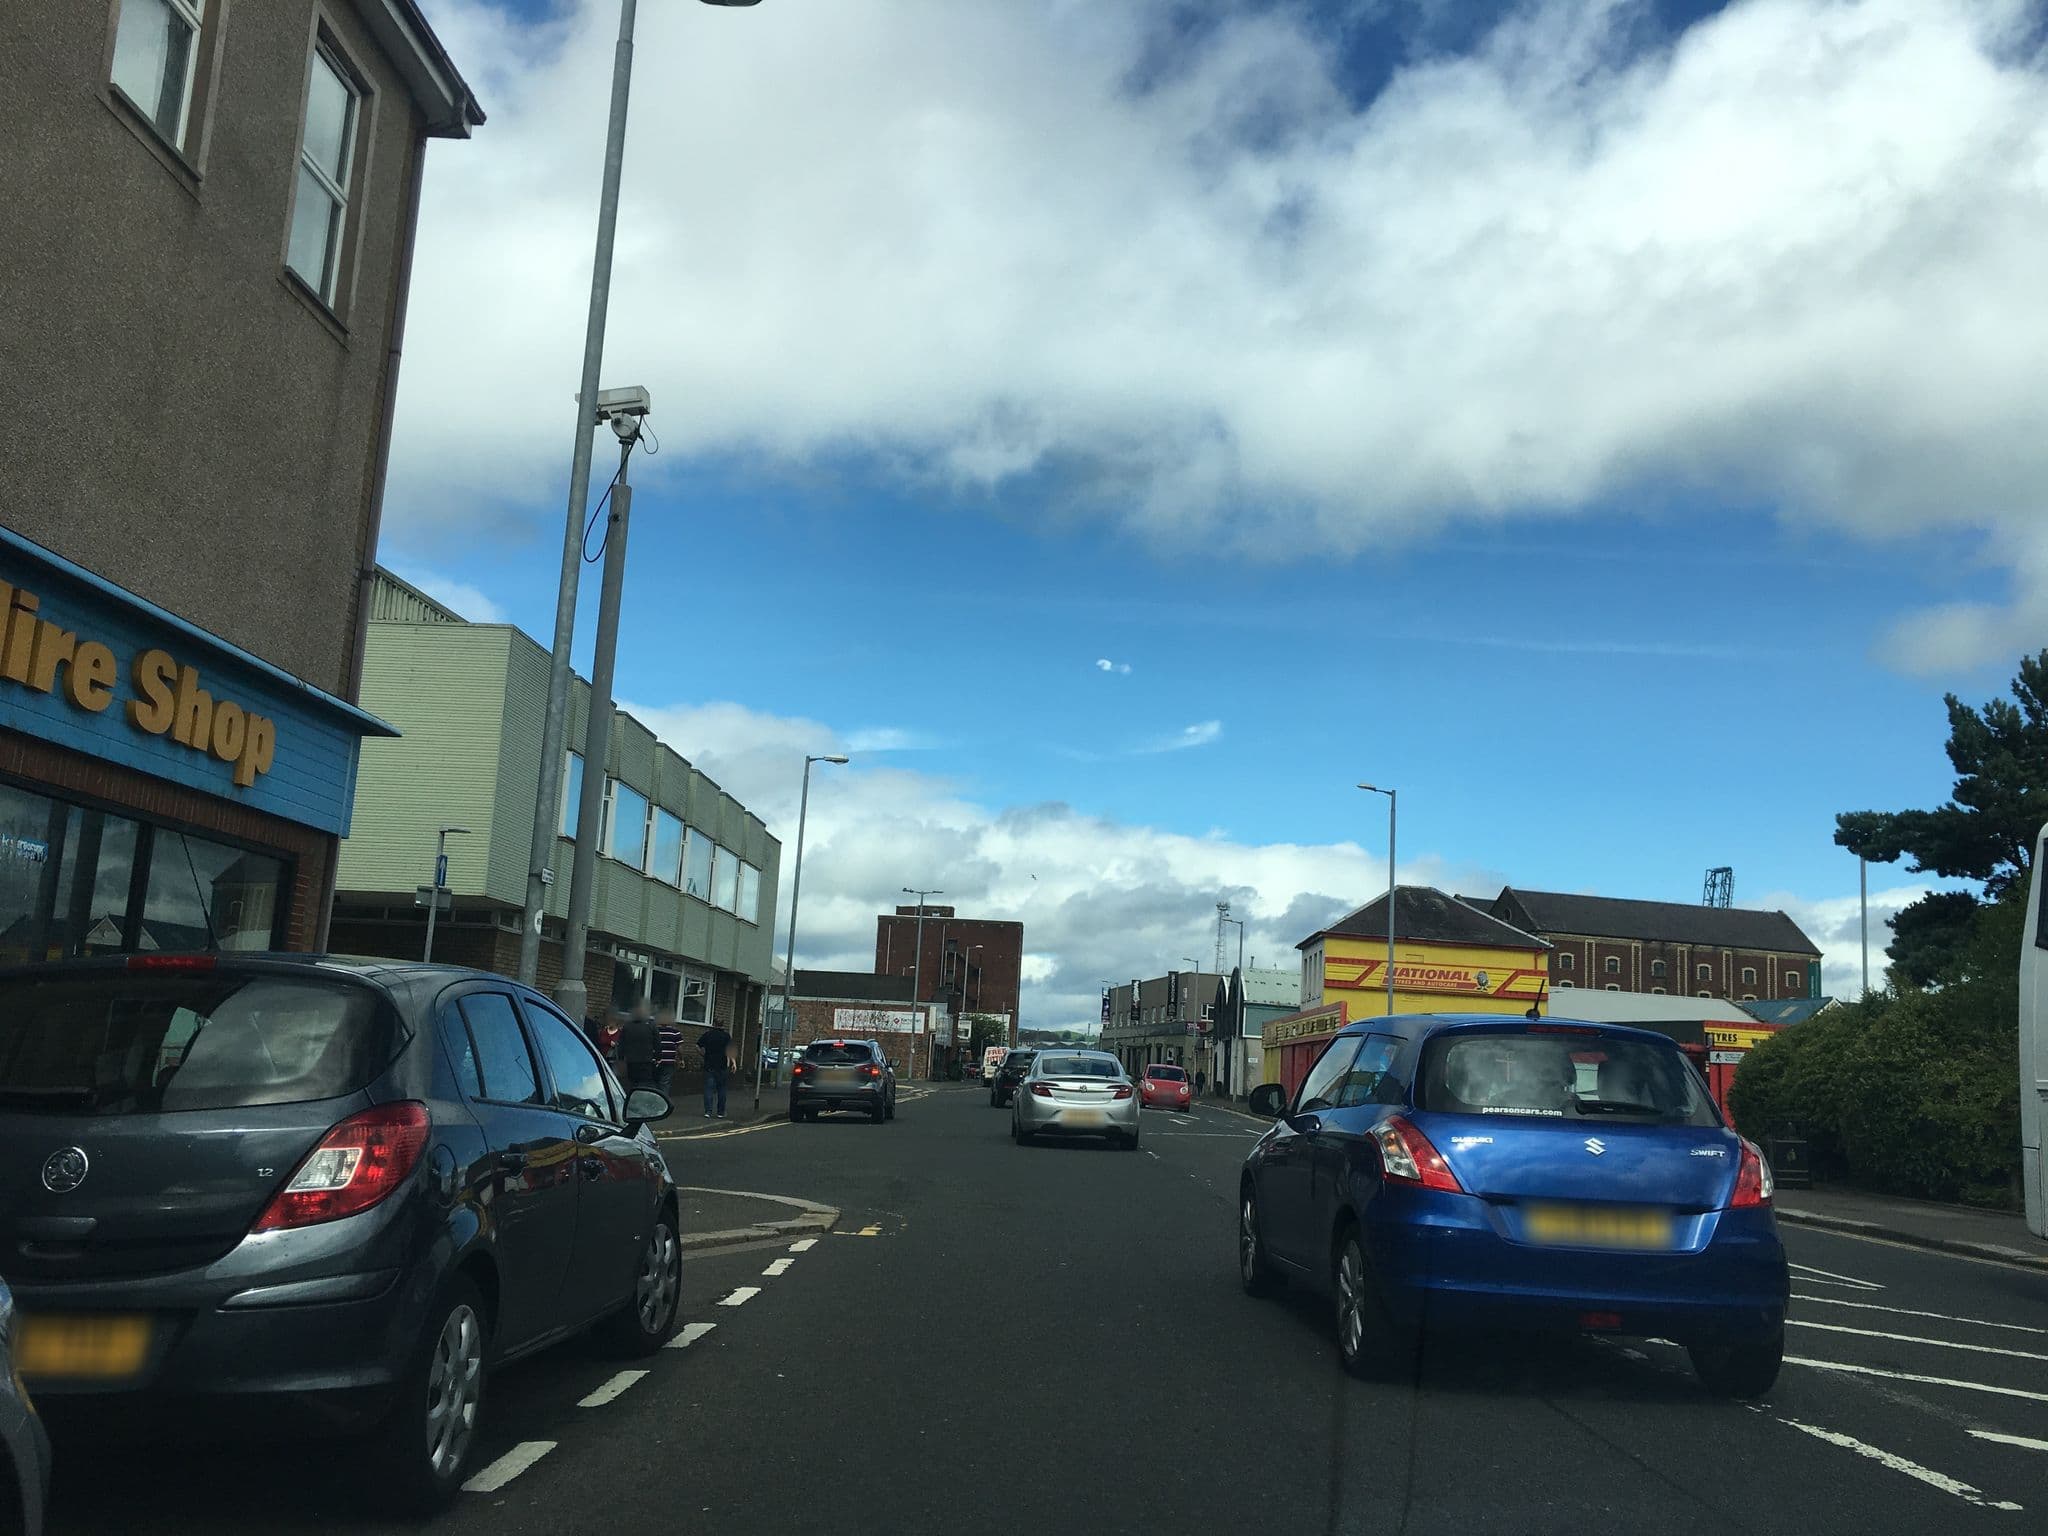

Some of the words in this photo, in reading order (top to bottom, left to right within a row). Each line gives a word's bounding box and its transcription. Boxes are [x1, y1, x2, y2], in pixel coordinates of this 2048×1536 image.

[126, 649, 275, 787] Shop
[1385, 966, 1472, 981] NATIONAL
[1482, 1106, 1563, 1117] pearsoncars.com
[1690, 1149, 1726, 1157] SWIFT
